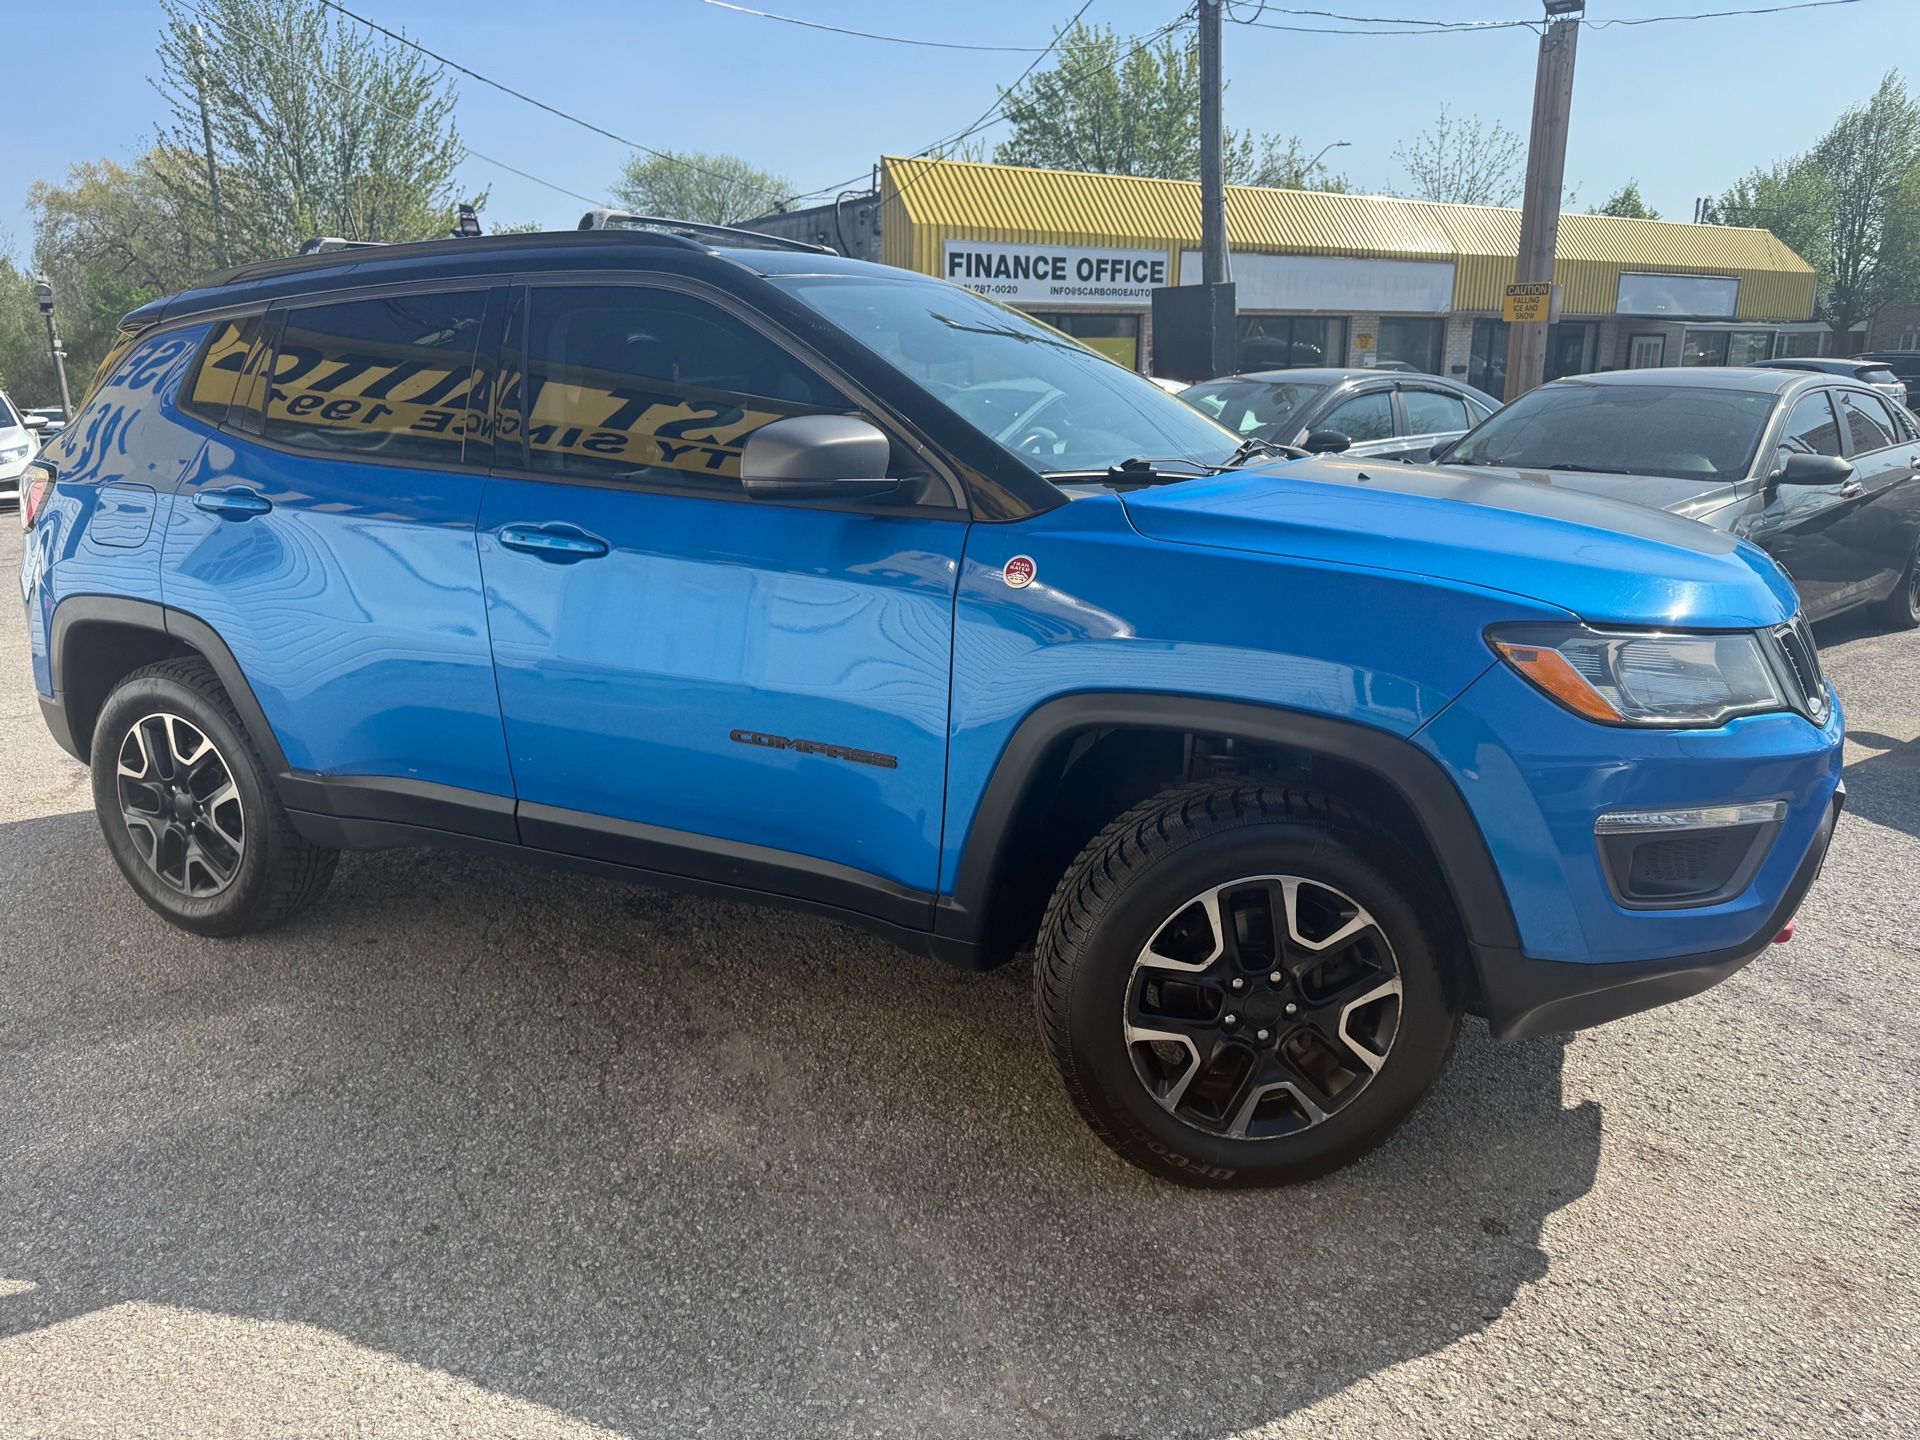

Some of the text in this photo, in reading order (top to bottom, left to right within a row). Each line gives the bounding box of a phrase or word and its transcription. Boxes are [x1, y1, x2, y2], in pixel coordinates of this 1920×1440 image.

[948, 252, 1164, 283] FINANCE OFFICE
[974, 284, 1018, 294] 287-0020
[1050, 286, 1151, 297] INFO@SCARBOROEAUTO
[1507, 284, 1548, 296] CAUTION
[1513, 296, 1540, 304] FALLING
[1513, 304, 1539, 312] ICE AND
[1515, 312, 1535, 320] SNOW
[730, 729, 897, 769] COMPASS
